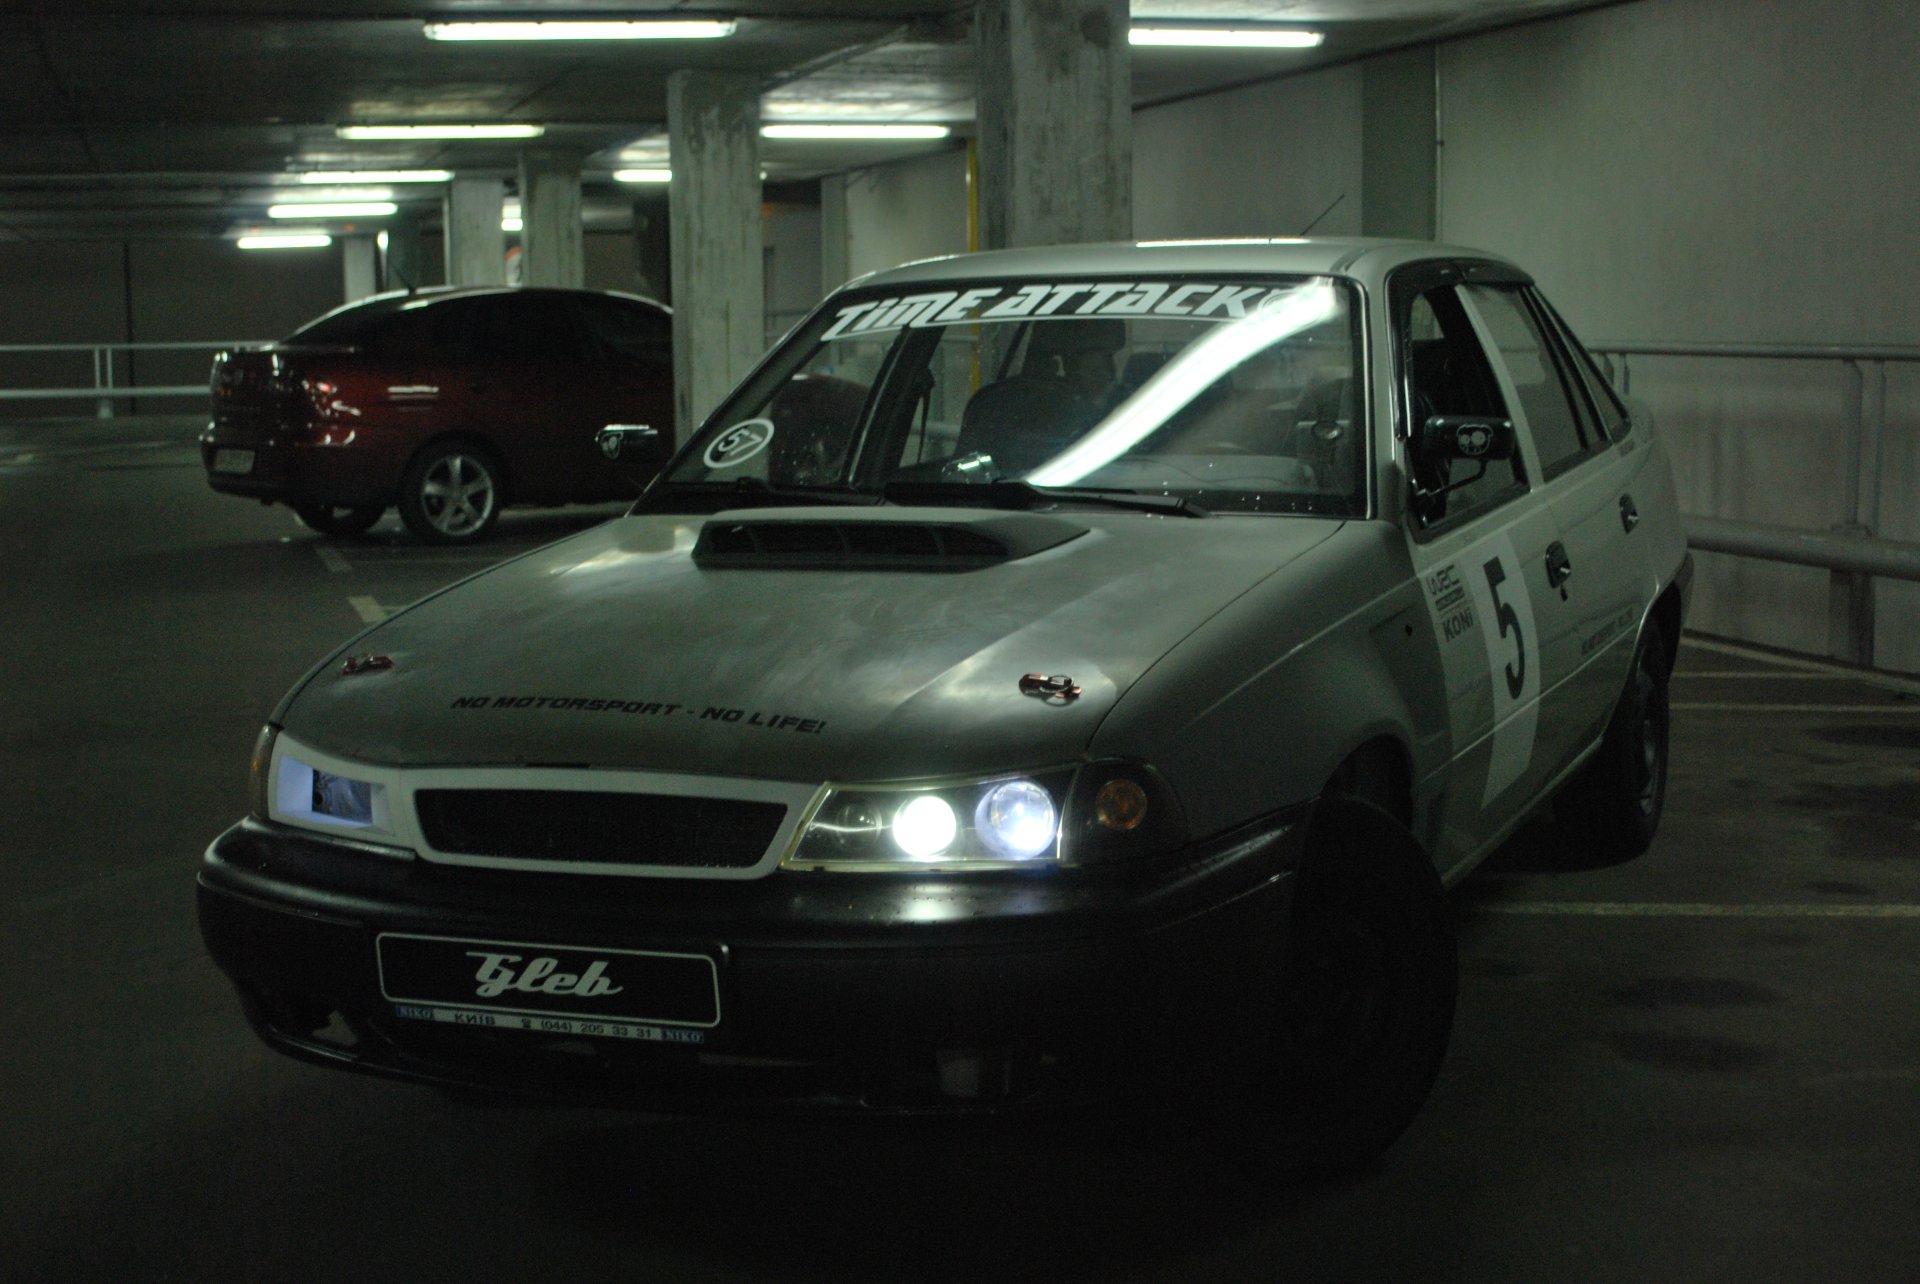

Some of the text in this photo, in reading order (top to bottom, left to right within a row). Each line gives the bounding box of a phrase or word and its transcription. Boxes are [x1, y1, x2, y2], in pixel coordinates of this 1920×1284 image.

[718, 428, 764, 456] 57
[1483, 557, 1525, 700] 5
[451, 696, 491, 710] NO
[492, 697, 682, 716] MOTORSPORT
[700, 707, 744, 724] NO
[746, 713, 828, 735] LIFE!
[540, 1019, 653, 1039] (044) 205 33 31
